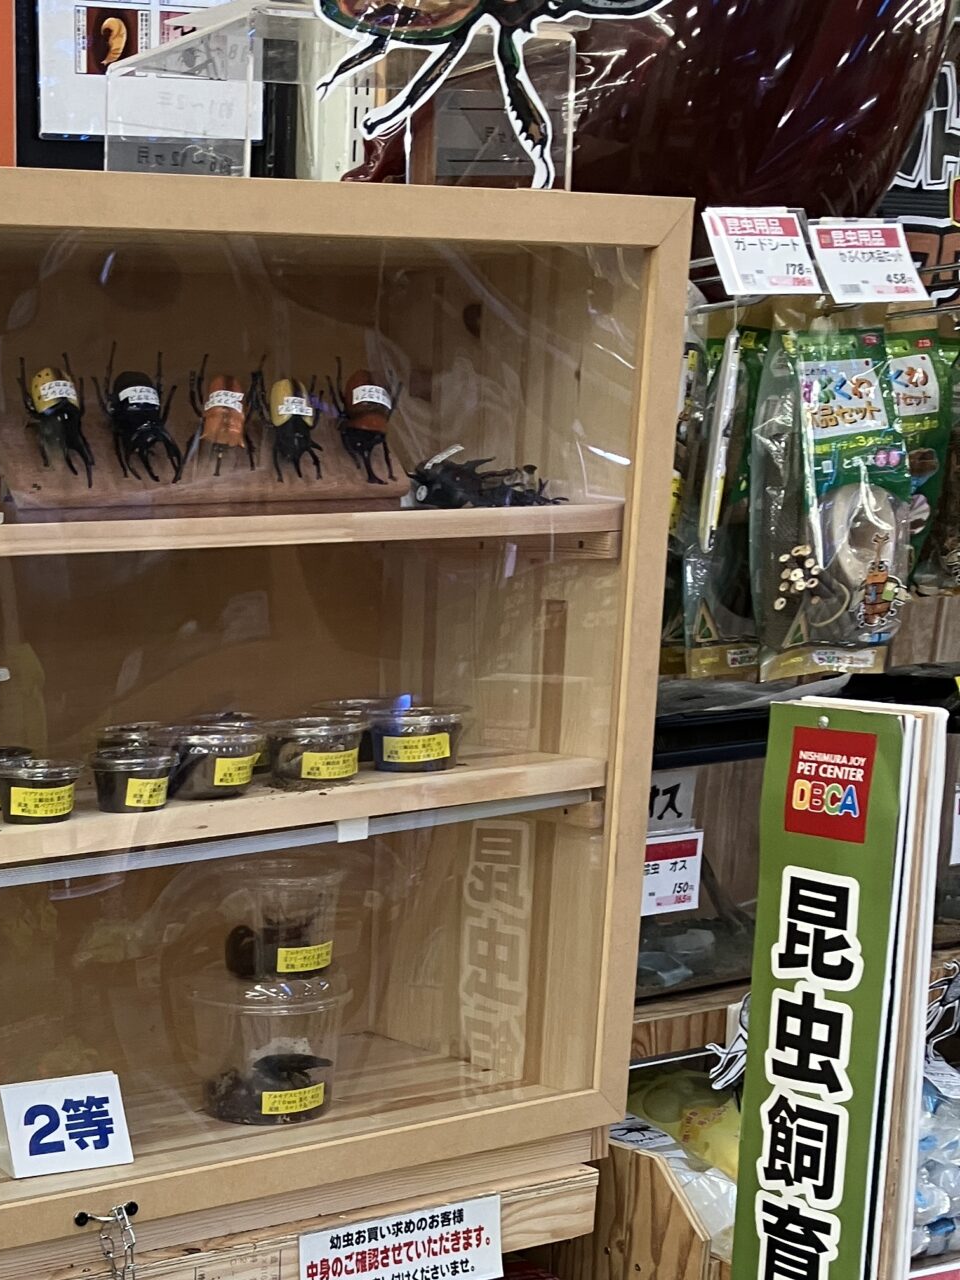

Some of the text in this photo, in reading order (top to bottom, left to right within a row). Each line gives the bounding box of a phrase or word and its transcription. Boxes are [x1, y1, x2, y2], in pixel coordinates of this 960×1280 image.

[725, 217, 784, 236] 昆虫用品
[733, 237, 800, 252] ガードシート
[830, 229, 886, 248] 昆虫用品
[798, 749, 867, 768] NISHIMURA JOY
[796, 761, 865, 783] PET CENTER
[669, 860, 688, 873] オス
[22, 1094, 115, 1157] 2等
[329, 1207, 465, 1251] 幼虫お買い求めのお客様
